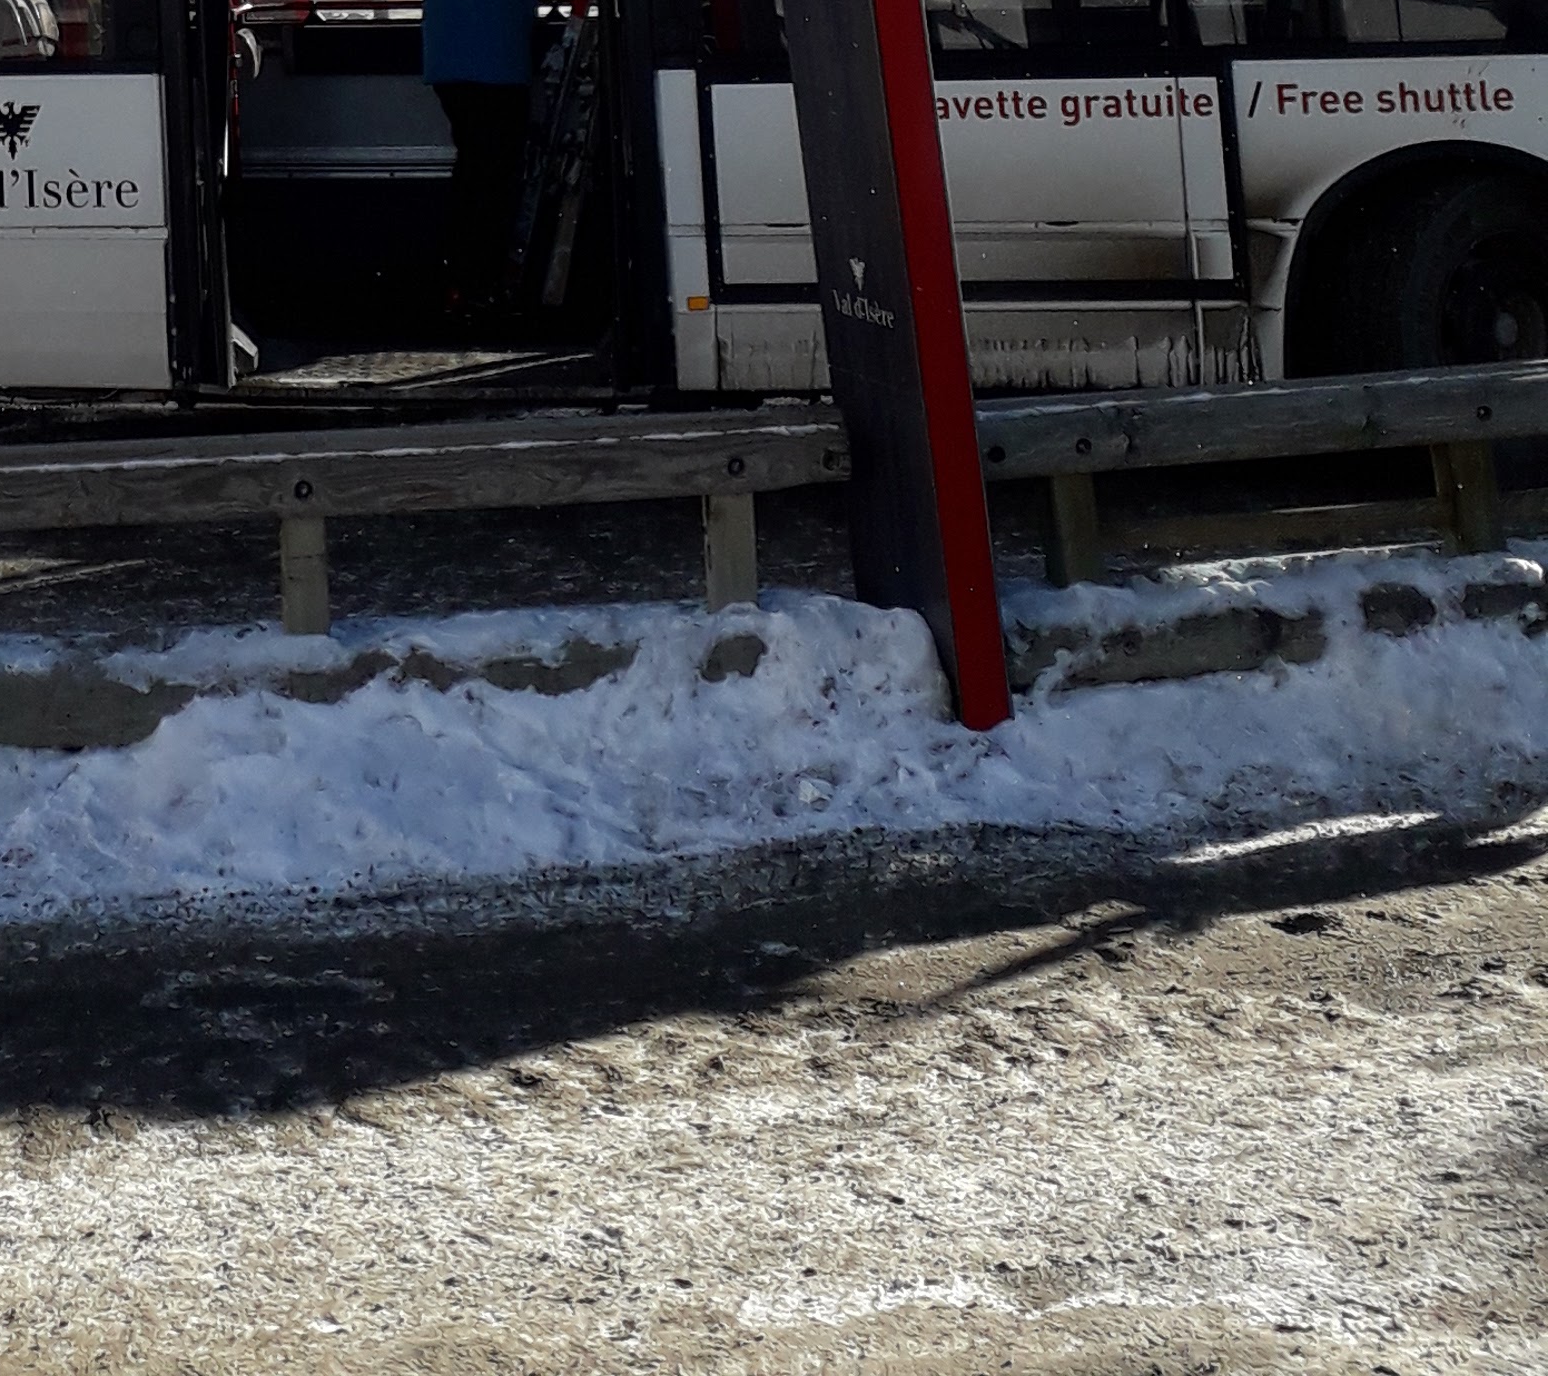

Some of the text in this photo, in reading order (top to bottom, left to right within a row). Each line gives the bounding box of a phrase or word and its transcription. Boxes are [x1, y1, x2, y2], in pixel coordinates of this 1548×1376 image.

[936, 84, 1215, 127] avette gratuite
[1276, 83, 1364, 115] Free
[1376, 79, 1515, 113] shuttle
